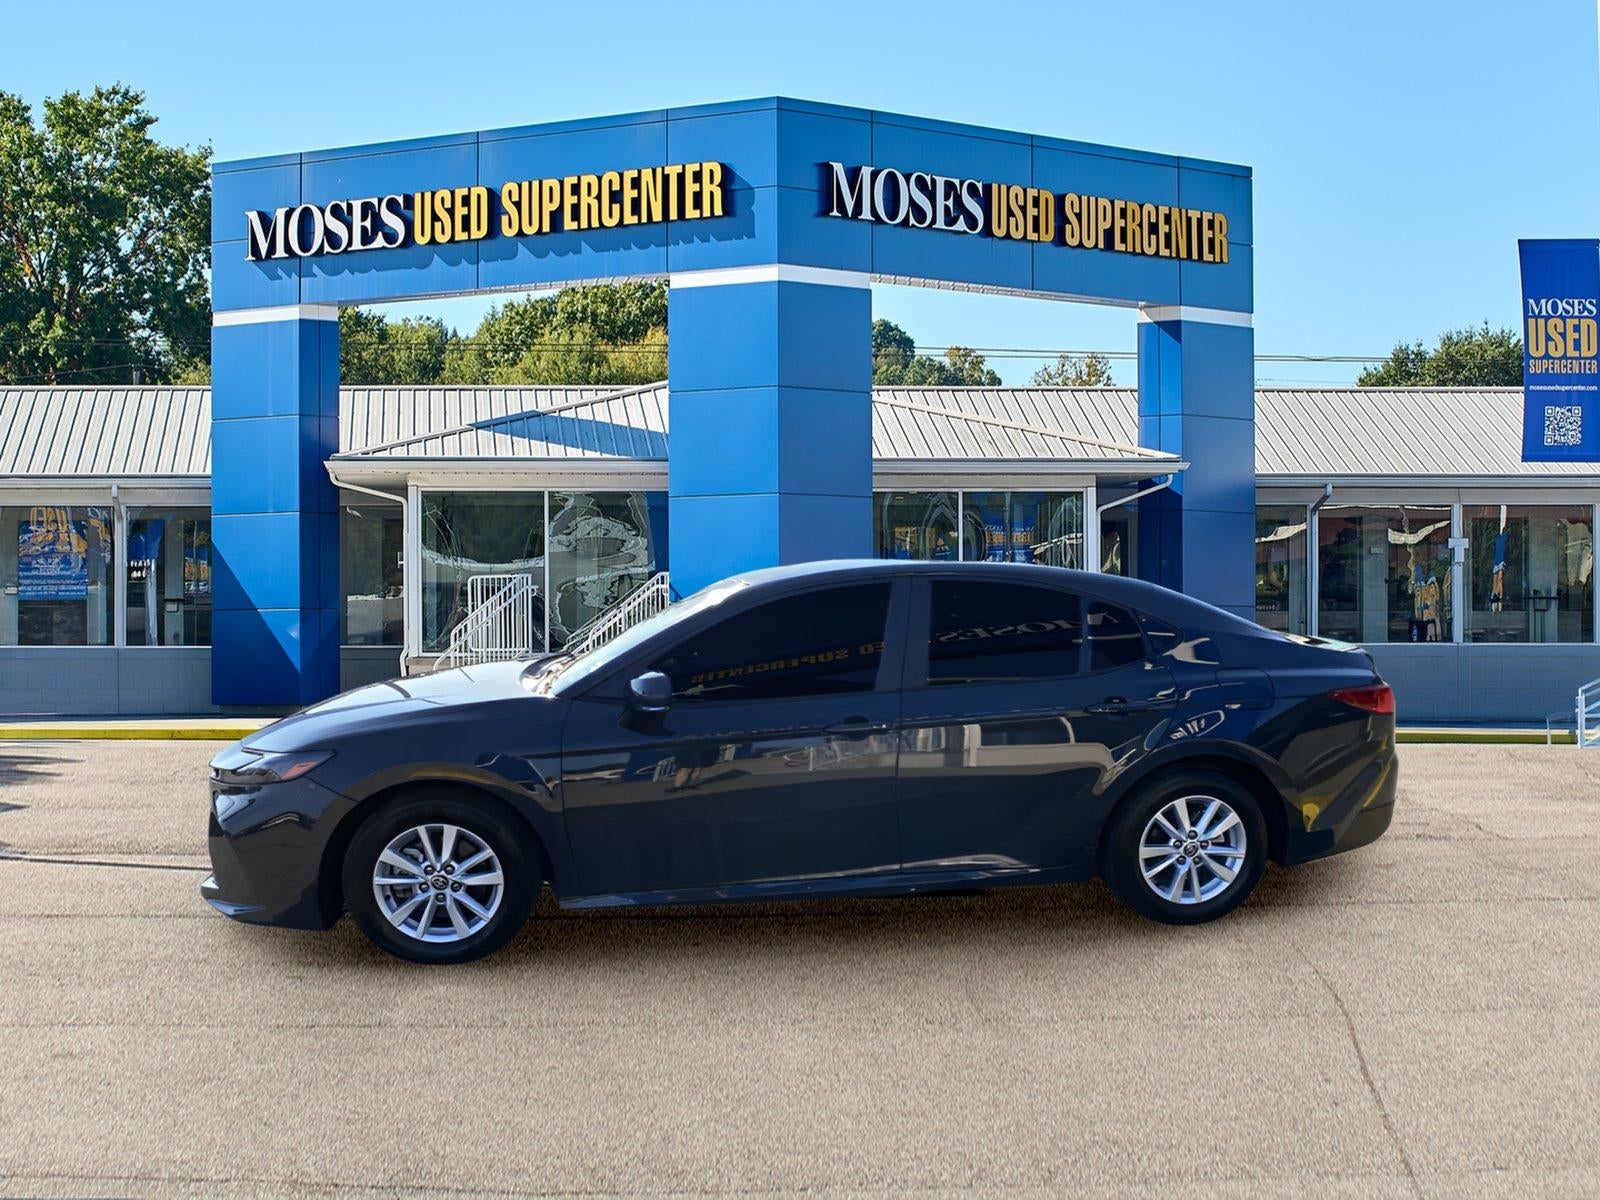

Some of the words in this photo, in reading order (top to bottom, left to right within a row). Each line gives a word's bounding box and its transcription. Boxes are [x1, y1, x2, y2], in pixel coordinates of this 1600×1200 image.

[244, 193, 406, 262] MOSES
[412, 186, 488, 246] USED
[500, 161, 724, 236] SUPERCENTER
[828, 161, 984, 235] MOSES
[991, 182, 1055, 242] USED
[1064, 192, 1229, 264] SUPERCENTER
[1527, 298, 1597, 317] MOSES
[1528, 318, 1598, 358] USED
[1529, 359, 1598, 374] SUPERCENTER
